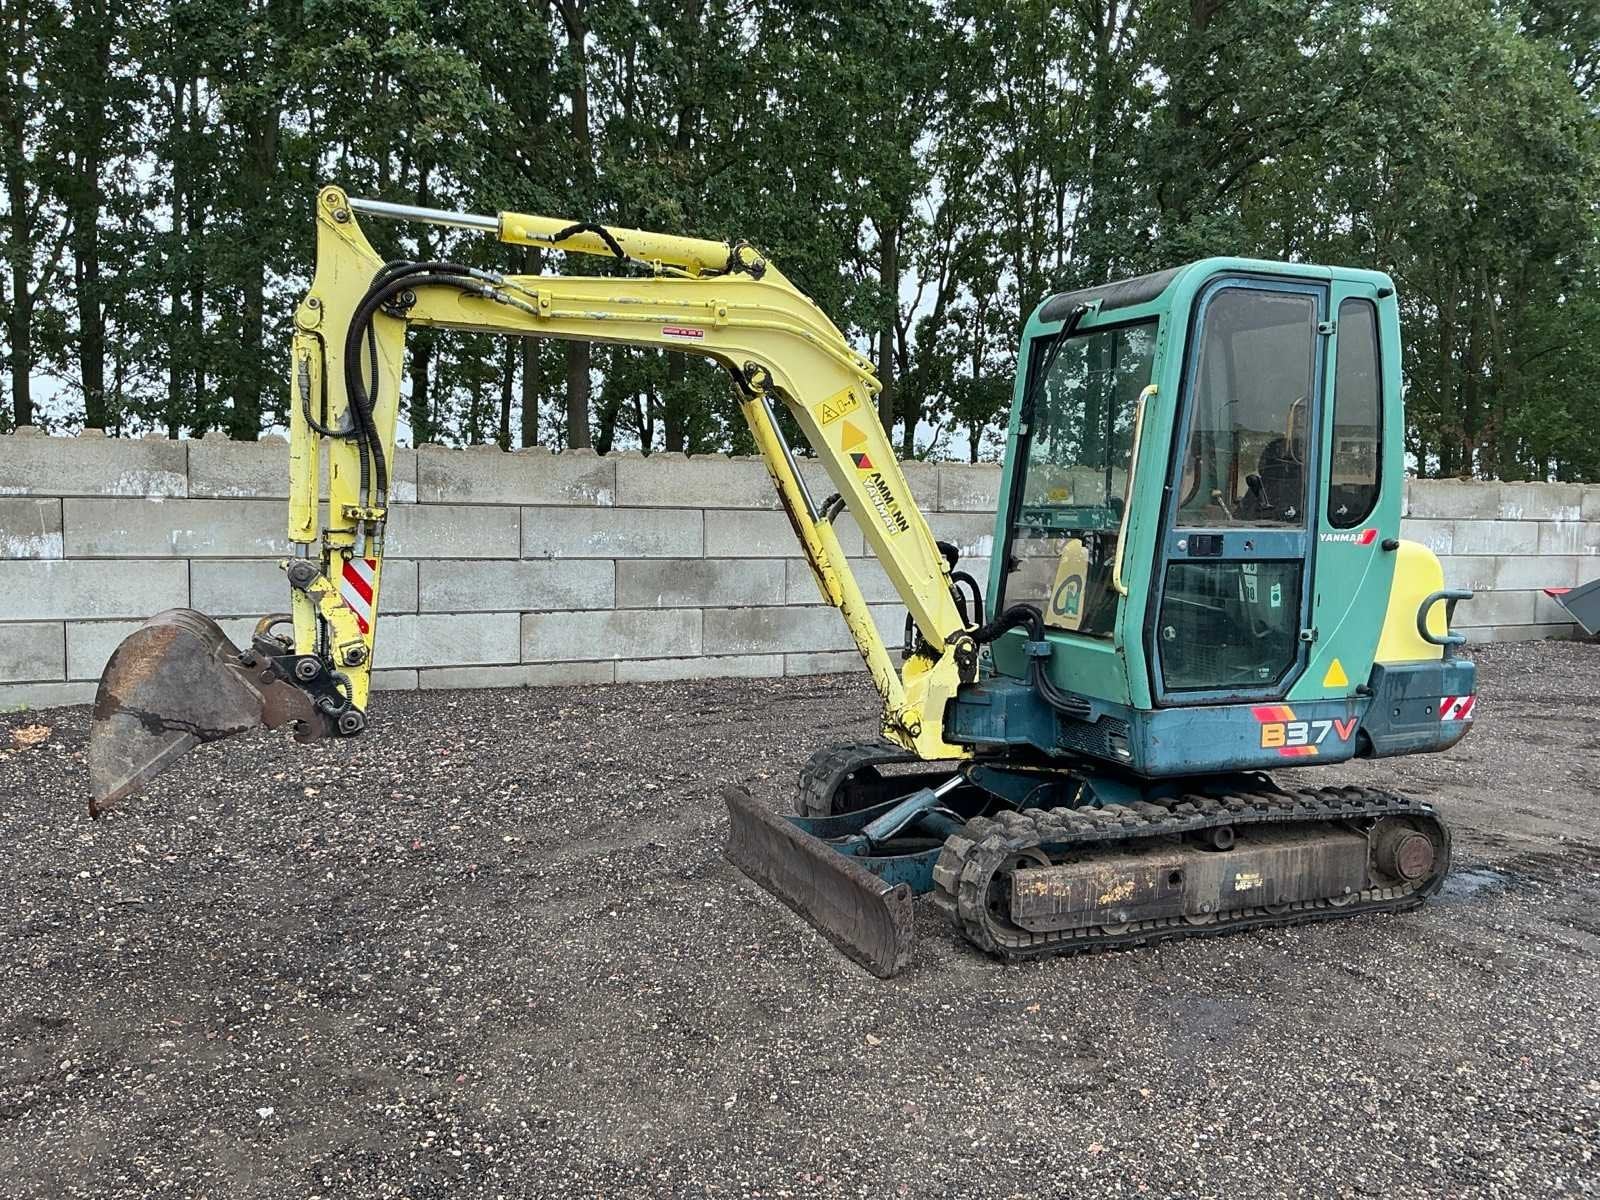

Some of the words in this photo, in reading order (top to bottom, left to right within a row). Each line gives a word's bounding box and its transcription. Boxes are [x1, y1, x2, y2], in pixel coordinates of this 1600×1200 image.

[863, 476, 899, 536] YANMAR
[870, 472, 910, 532] AMMANN
[1319, 532, 1364, 542] YANMAR
[1261, 718, 1358, 748] B37V
